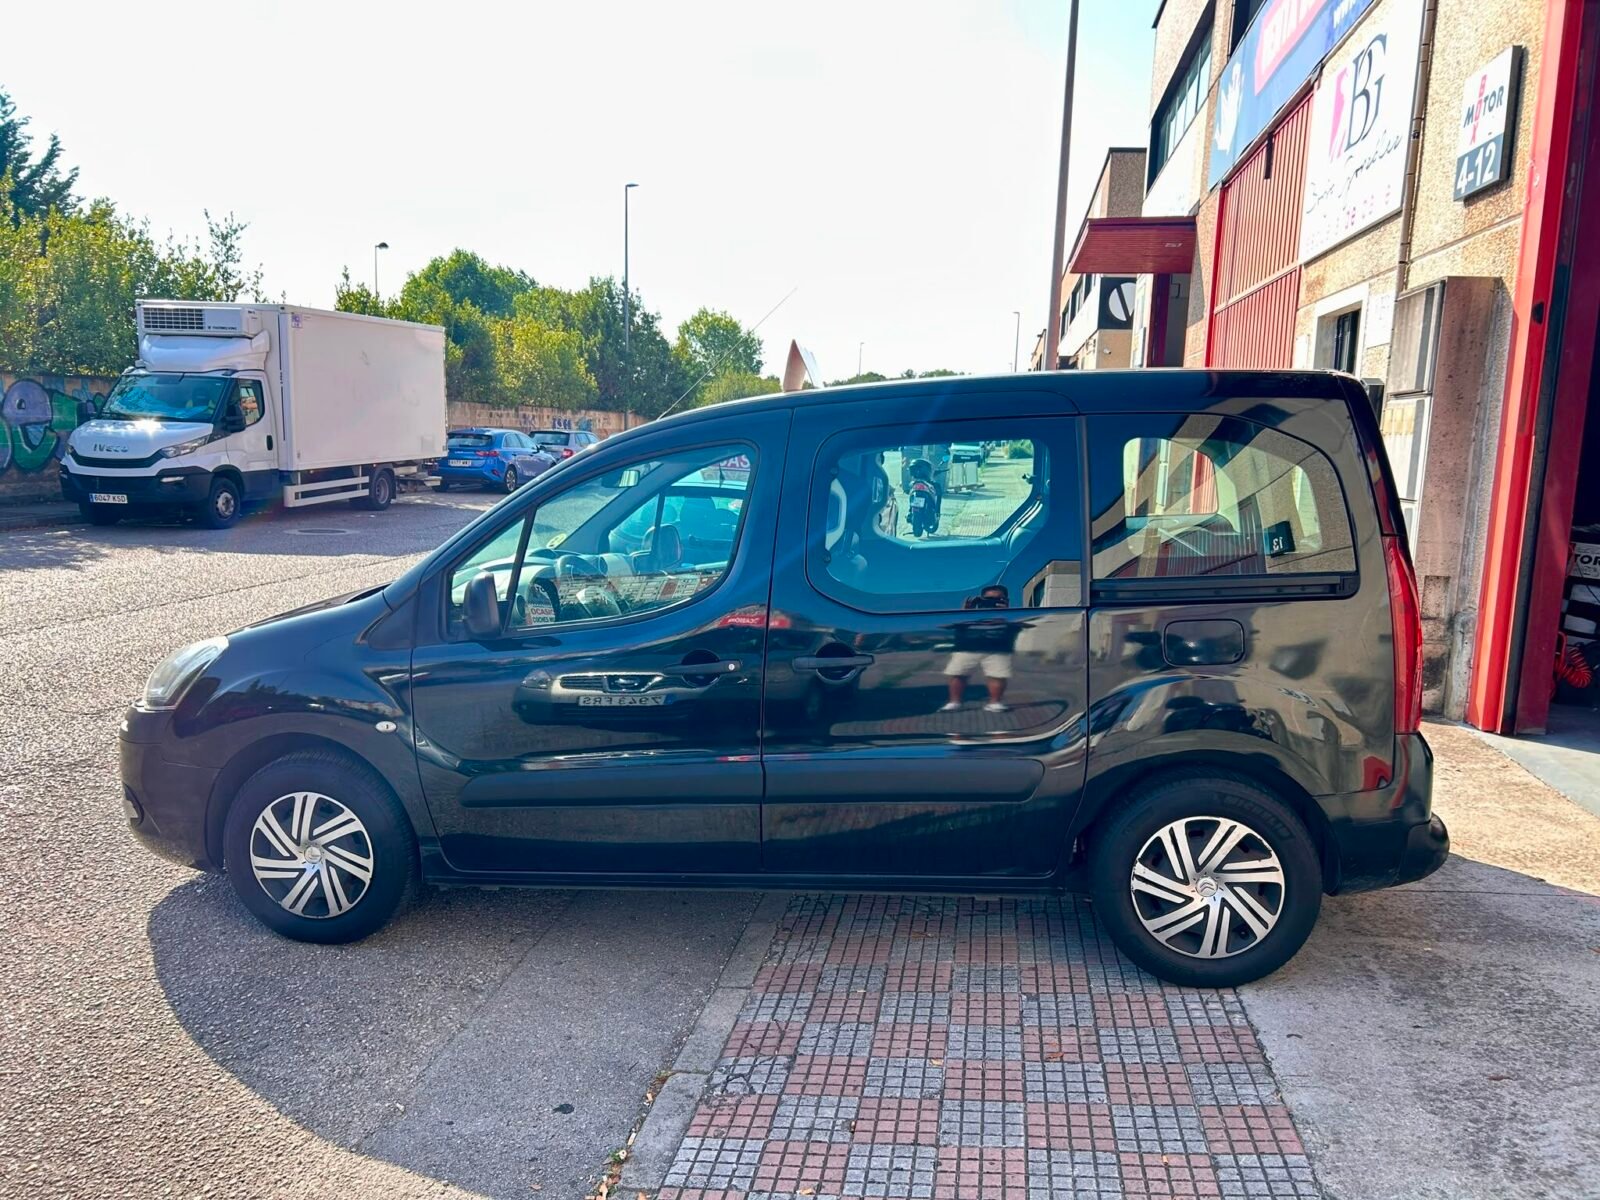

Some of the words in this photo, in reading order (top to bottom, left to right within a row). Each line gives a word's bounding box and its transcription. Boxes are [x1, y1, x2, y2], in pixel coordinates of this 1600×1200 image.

[1463, 85, 1505, 129] MOTOR
[1456, 141, 1497, 195] 4-12
[93, 443, 129, 453] IVECO
